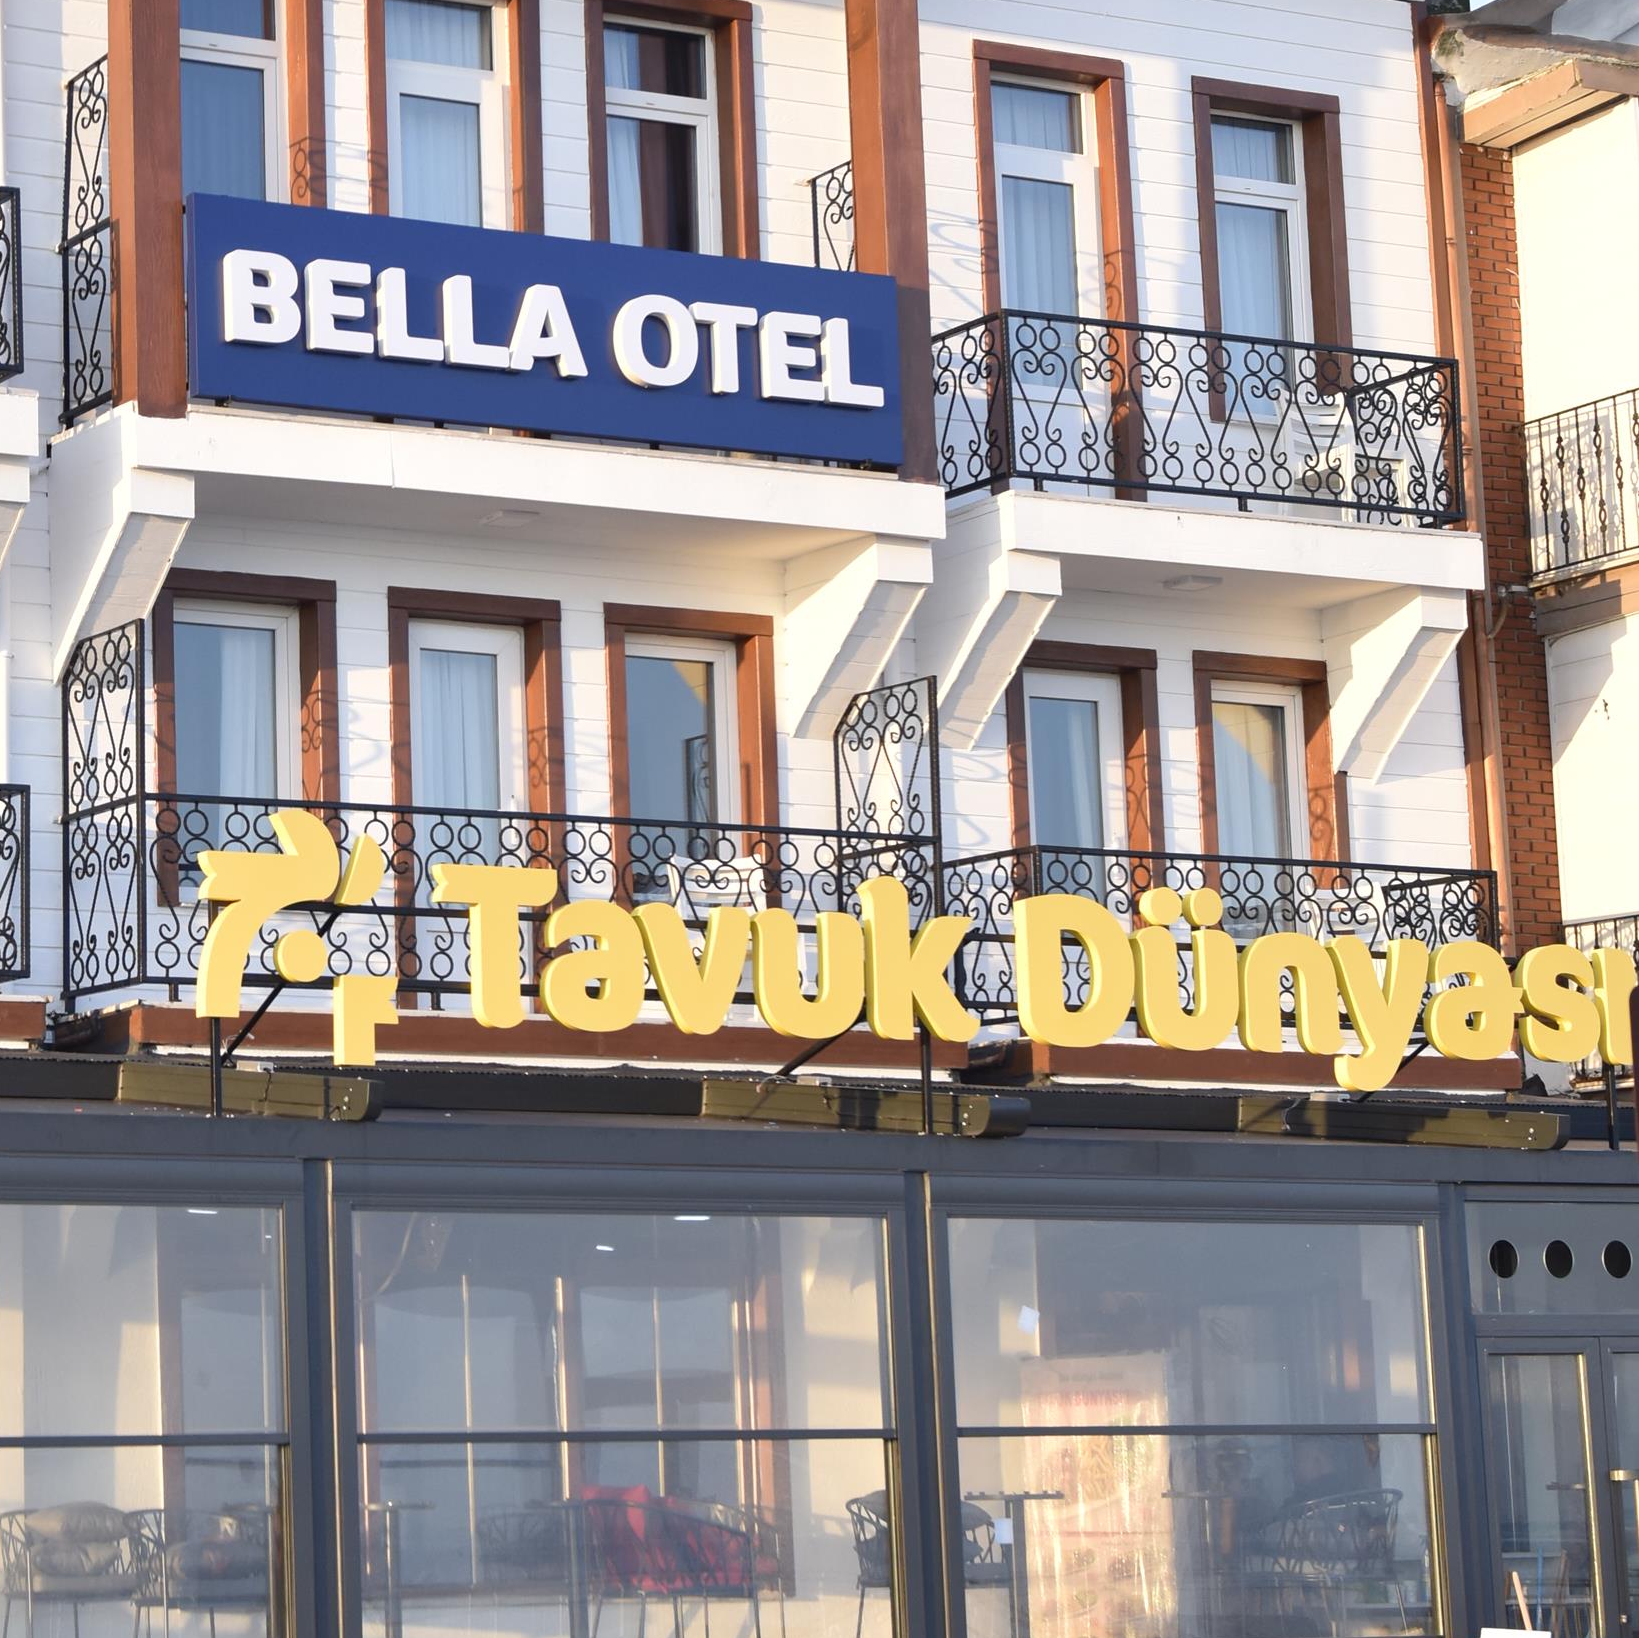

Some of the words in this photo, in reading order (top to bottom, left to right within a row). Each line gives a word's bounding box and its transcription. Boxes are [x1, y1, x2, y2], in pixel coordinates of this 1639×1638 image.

[222, 248, 589, 379] BELLA
[612, 293, 886, 409] OTEL
[430, 862, 980, 1043] Tavuk
[1011, 885, 1639, 1093] Dünyası
